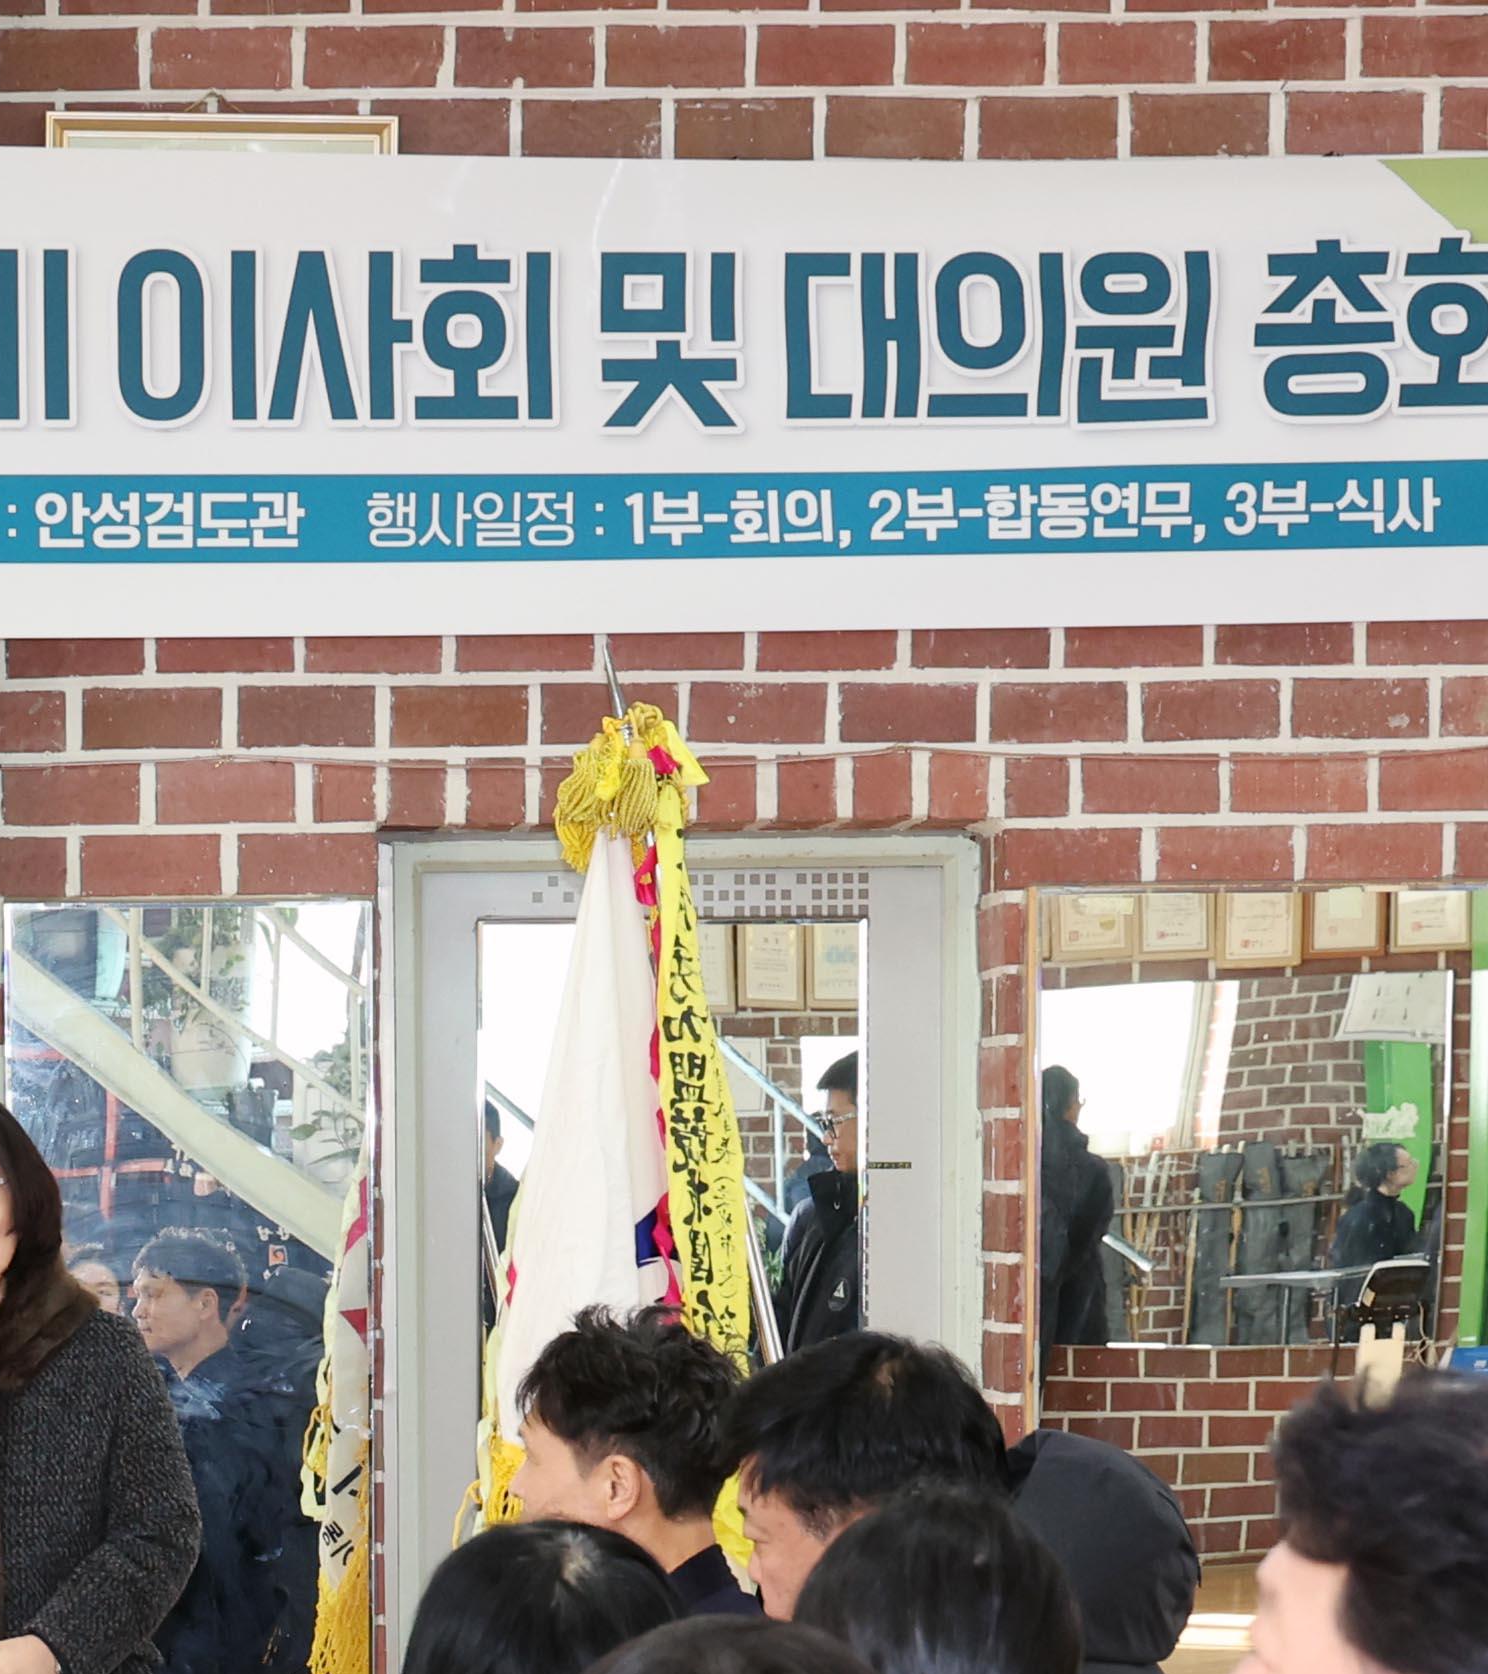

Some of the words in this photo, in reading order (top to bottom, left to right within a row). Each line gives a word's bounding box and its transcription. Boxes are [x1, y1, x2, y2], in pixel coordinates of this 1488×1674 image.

[116, 244, 553, 420] 이사회
[599, 251, 737, 427] 및
[783, 250, 1211, 424] 대의원
[35, 491, 306, 549] 안성검도관
[366, 491, 575, 548] 행사일정
[625, 489, 852, 551] 1부-회의,
[868, 486, 1206, 547] 2부-합동연무,
[1223, 484, 1441, 537] 3부-식사
